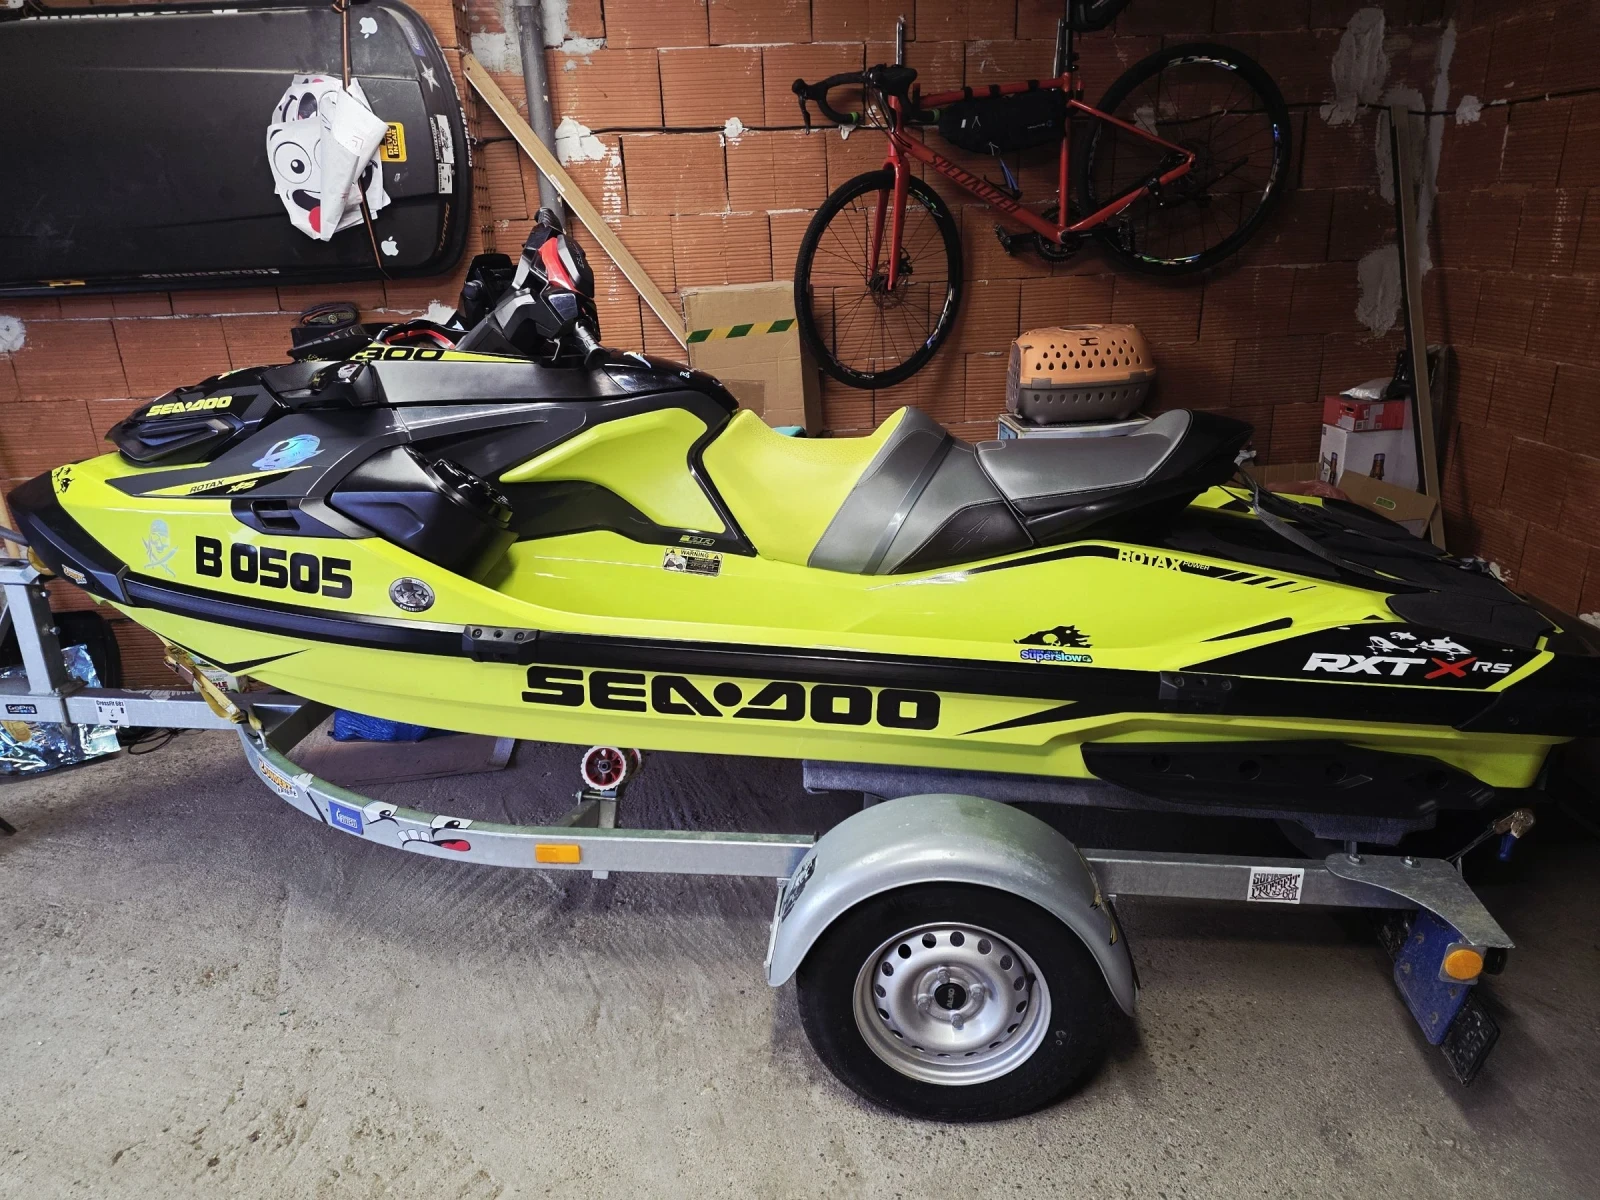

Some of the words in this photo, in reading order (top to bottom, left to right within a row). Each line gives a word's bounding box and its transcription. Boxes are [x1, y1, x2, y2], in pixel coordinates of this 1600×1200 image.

[932, 154, 1021, 214] SPECIALIZED
[354, 347, 446, 361] 300
[190, 480, 225, 493] ROTAX
[681, 550, 709, 558] WARNING
[1118, 549, 1182, 572] ROTAX
[1182, 560, 1210, 571] POWER
[196, 535, 222, 577] B
[230, 542, 353, 599] 0505
[1021, 650, 1082, 662] Superslow
[1302, 652, 1427, 676] RXT
[1424, 657, 1478, 680] X
[1472, 661, 1513, 674] RS
